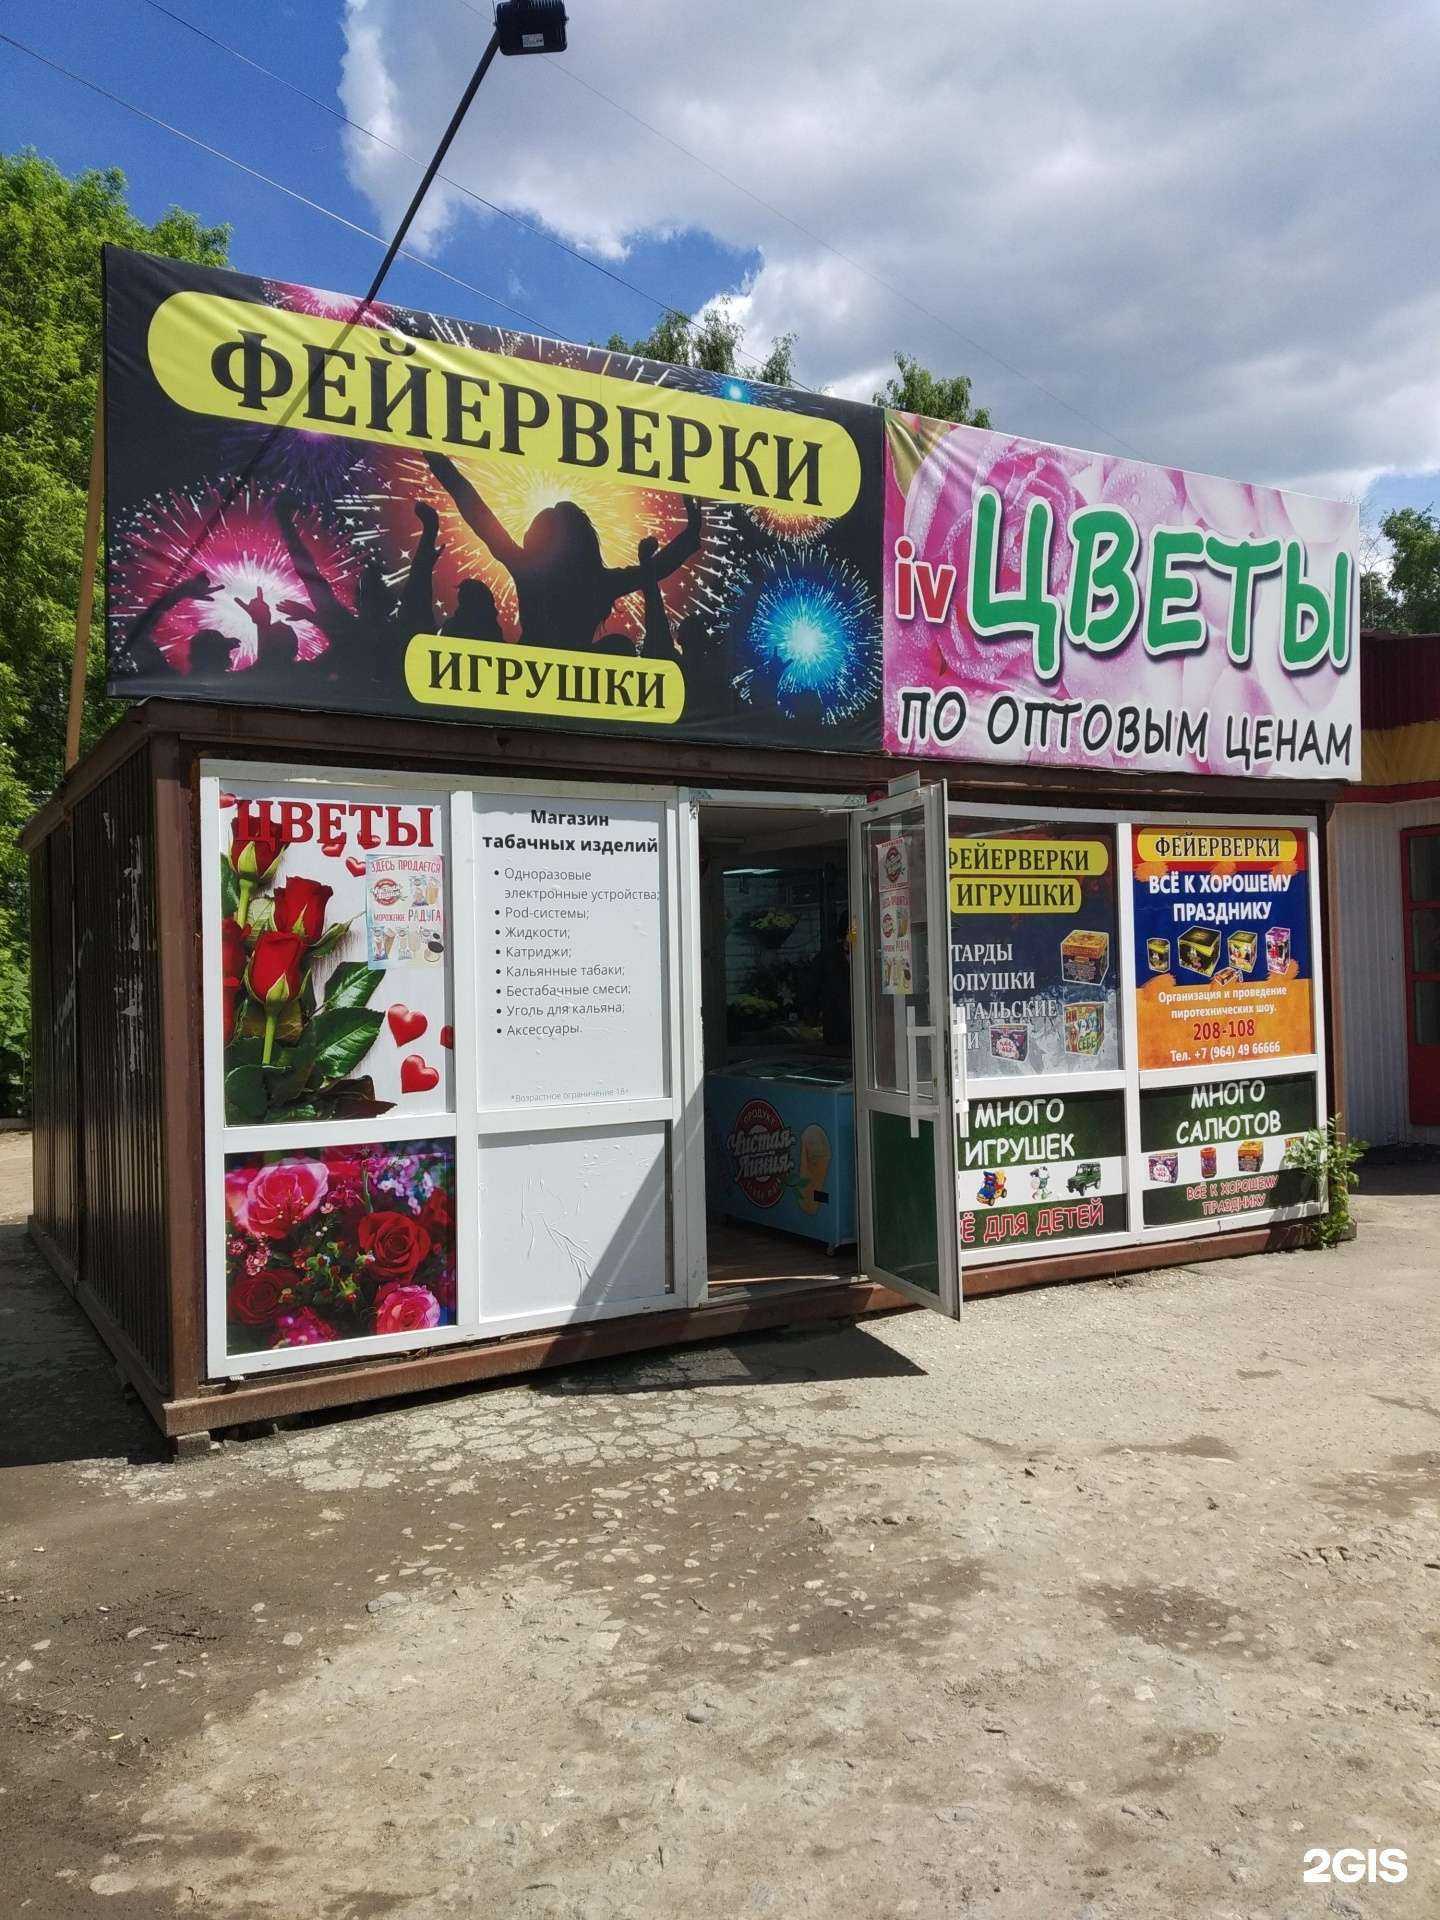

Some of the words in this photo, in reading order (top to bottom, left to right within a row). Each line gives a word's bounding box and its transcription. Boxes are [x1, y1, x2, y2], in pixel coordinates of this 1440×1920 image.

[210, 329, 825, 507] ФЕЙЕРВЕРКИ
[895, 537, 955, 623] iv
[969, 486, 1353, 680] ЦВЕТЫ
[427, 649, 667, 709] ИГРУШКИ
[900, 689, 967, 743] ПО
[987, 698, 1209, 758] ОПТОВЫМ
[1225, 718, 1353, 771] ЦЕНАМ
[234, 799, 434, 851] ЦВЕТЫ
[530, 809, 610, 827] Магазин
[482, 834, 576, 851] табачных
[580, 837, 658, 856] изделий
[1155, 832, 1280, 857] ФЕЙЕРВЕРКИ
[371, 860, 395, 873] ЗДЕСЬ
[504, 867, 592, 882] Одноразовые
[1150, 871, 1180, 894] ВСЁ
[1184, 874, 1195, 894] К
[1199, 874, 1292, 893] ХОРОШЕМУ
[504, 889, 588, 901] электронные
[591, 888, 660, 902] устройства;
[956, 883, 1074, 907] ИГРУШКИ
[408, 909, 441, 922] РАДУГА
[505, 906, 590, 920] Pod-системы;
[1173, 901, 1272, 924] ПРАЗДНИКУ
[505, 927, 571, 940] Жидкости;
[506, 946, 572, 960] Катриджи;
[506, 966, 577, 977] Кальянные
[581, 964, 625, 977] табаки;
[506, 984, 589, 997] Бестабачные
[592, 984, 631, 996] смеси;
[1158, 989, 1221, 1005] Организация
[1224, 991, 1230, 999] и
[1232, 986, 1288, 1001] проведение
[507, 1005, 544, 1017] Уголь
[547, 1004, 569, 1017] для
[572, 1003, 625, 1015] кальяна;
[1171, 1006, 1254, 1021] пиротехнических
[1256, 1003, 1277, 1015] шоу.
[507, 1023, 583, 1038] Аксессуары.
[1193, 1019, 1255, 1041] 208-108
[1170, 1050, 1192, 1062] Тел.
[1194, 1048, 1208, 1060] +7
[1210, 1045, 1236, 1060] (964)
[1238, 1043, 1250, 1056] 49
[1252, 1041, 1281, 1054] 66666
[1190, 1080, 1266, 1110] МНОГО
[974, 1098, 1065, 1129] МНОГО
[1176, 1110, 1282, 1145] САЛЮТОВ
[965, 1133, 1075, 1167] ИГРУШЕК
[1210, 1183, 1218, 1197] К
[1221, 1175, 1279, 1195] ХОРОШЕМУ
[1202, 1193, 1266, 1215] ПРАЗДНИКУ
[983, 1212, 1029, 1244] ДЛЯ
[1036, 1197, 1104, 1236] ДЕТЕЙ
